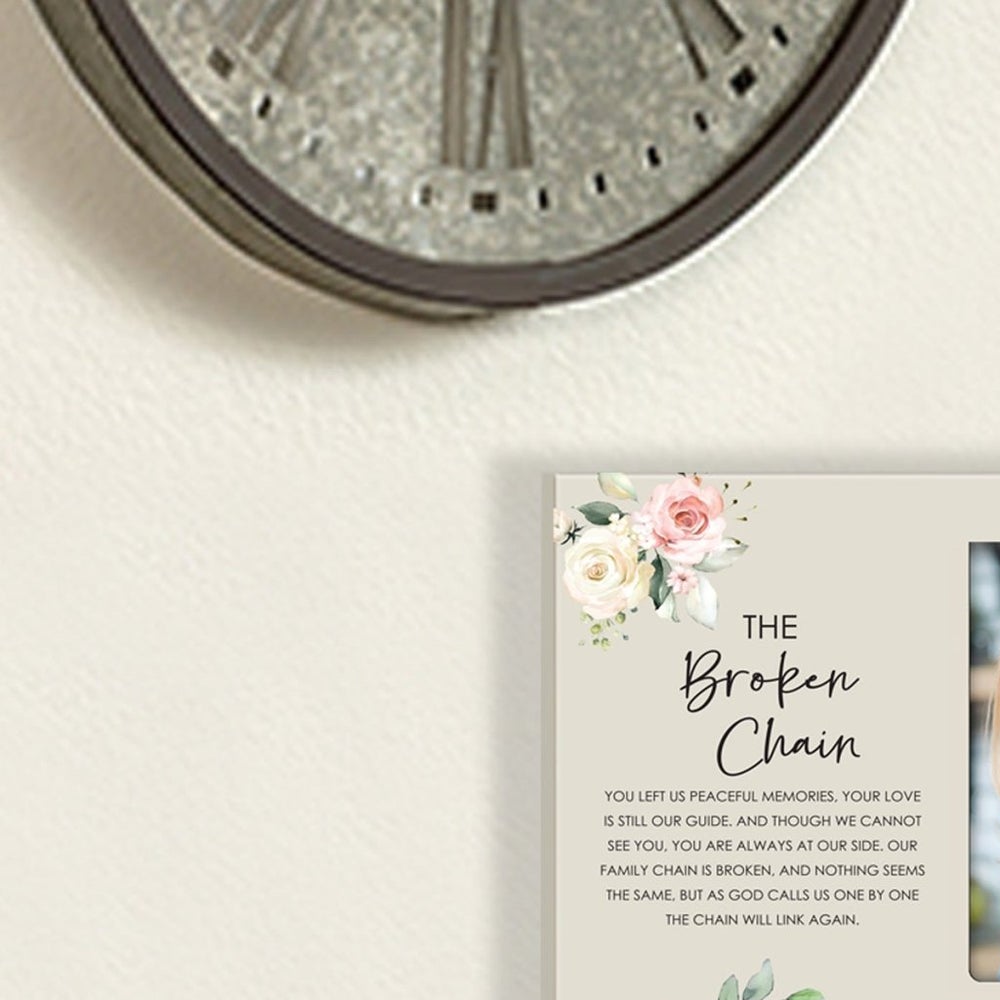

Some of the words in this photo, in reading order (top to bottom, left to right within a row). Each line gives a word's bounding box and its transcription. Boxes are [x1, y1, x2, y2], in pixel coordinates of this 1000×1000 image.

[742, 614, 798, 640] THE
[679, 649, 860, 714] Broken
[716, 716, 861, 777] Chain
[604, 790, 634, 803] YOU
[638, 790, 666, 802] LEFT
[669, 790, 686, 803] US
[689, 790, 758, 803] PEACEFUL
[761, 790, 838, 803] MEMORIES,
[842, 790, 881, 803] YOUR
[884, 790, 921, 803] LOVE
[604, 814, 615, 827] IS
[618, 815, 648, 827] STILL
[651, 815, 682, 827] OUR
[685, 815, 732, 827] GUIDE.
[736, 815, 768, 827] AND
[771, 815, 831, 827] THOUGH
[835, 815, 856, 827] WE
[860, 815, 922, 827] CANNOT
[607, 839, 630, 852] SEE
[634, 839, 667, 852] YOU,
[672, 839, 702, 852] YOU
[705, 839, 732, 852] ARE
[736, 839, 793, 852] ALWAYS
[796, 839, 813, 851] AT
[817, 839, 847, 852] OUR
[851, 839, 884, 852] SIDE.
[887, 839, 918, 852] OUR
[600, 864, 649, 877] FAMILY
[652, 864, 698, 877] CHAIN
[701, 864, 712, 877] IS
[716, 864, 775, 877] BROKEN,
[779, 864, 811, 876] AND
[814, 864, 880, 877] NOTHING
[883, 864, 926, 877] SEEMS
[606, 889, 630, 901] THE
[633, 889, 675, 901] SAME,
[680, 889, 703, 902] BUT
[707, 889, 725, 901] AS
[728, 888, 764, 902] GOD
[767, 888, 810, 902] CALLS
[813, 889, 830, 902] US
[833, 888, 864, 901] ONE
[868, 889, 885, 901] BY
[888, 888, 919, 902] ONE
[665, 913, 689, 926] THE
[692, 913, 738, 926] CHAIN
[742, 914, 772, 926] WILL
[776, 914, 805, 926] LINK
[808, 913, 859, 926] AGAIN.
